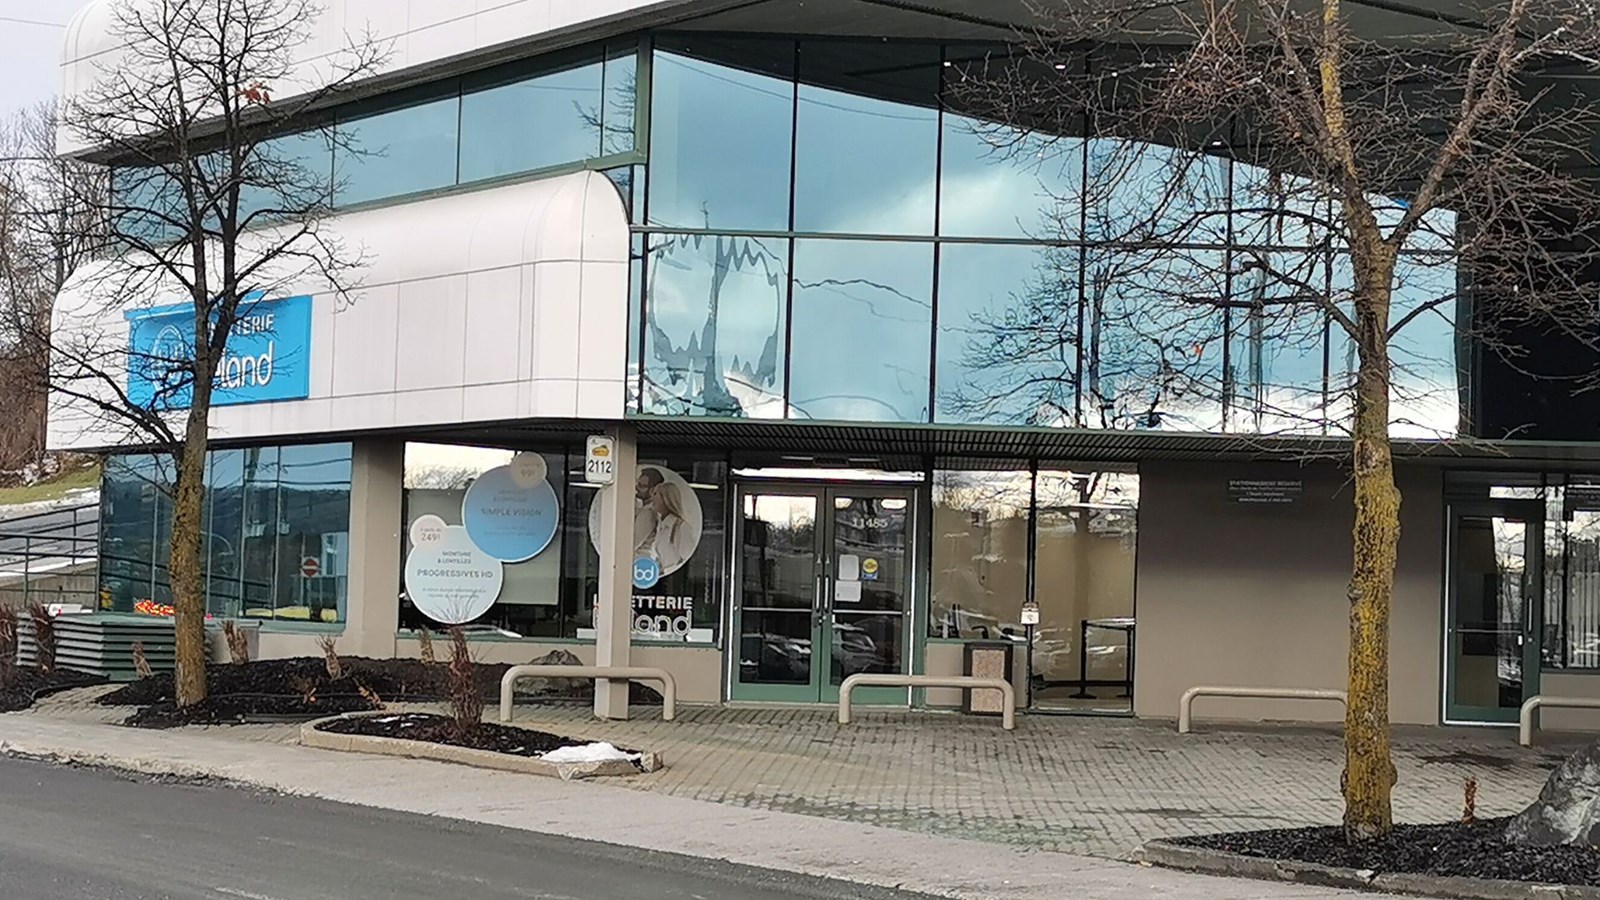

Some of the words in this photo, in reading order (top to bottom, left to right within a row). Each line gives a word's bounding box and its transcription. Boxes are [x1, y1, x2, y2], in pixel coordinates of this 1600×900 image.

[588, 459, 611, 474] 2112
[852, 518, 888, 529] 11485
[417, 569, 479, 577] PROGRESSIVES
[633, 564, 655, 581] bd
